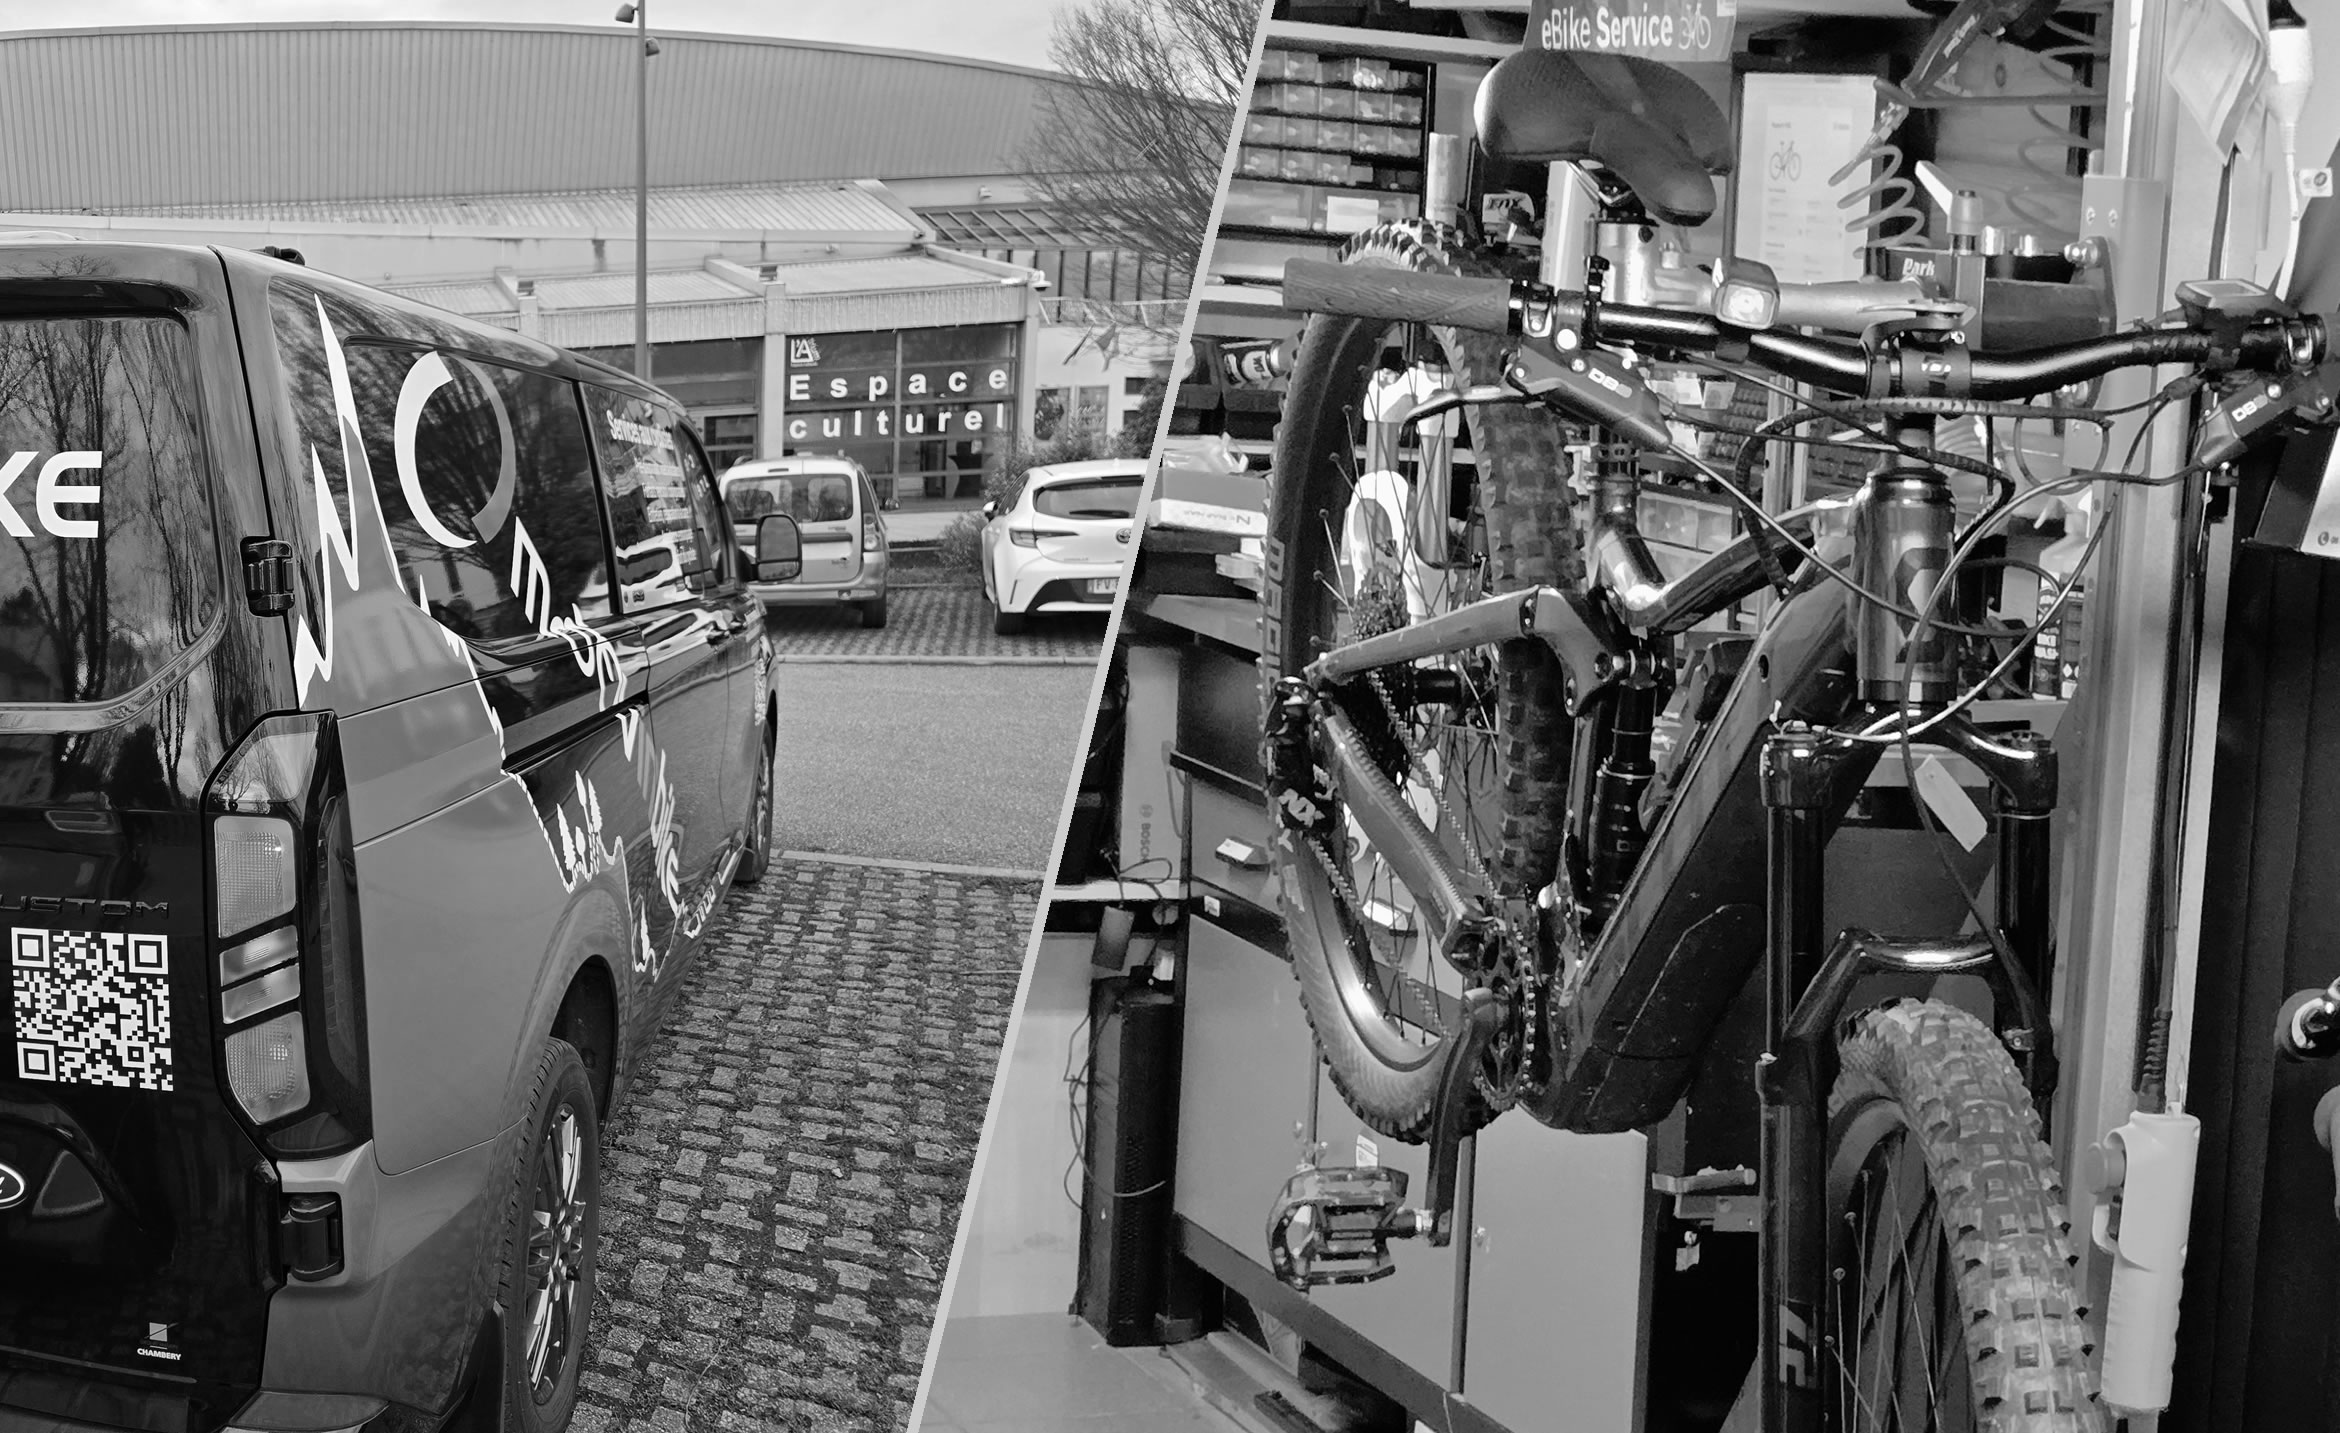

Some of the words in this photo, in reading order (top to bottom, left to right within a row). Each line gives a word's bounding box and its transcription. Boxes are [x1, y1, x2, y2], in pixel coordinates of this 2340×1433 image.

[1541, 6, 1591, 50] eBike
[1596, 2, 1673, 48] Service
[789, 369, 1008, 401] Espace
[789, 402, 1004, 439] culturel
[1140, 823, 1152, 861] BOSC
[137, 1348, 181, 1360] CHAMBERY
